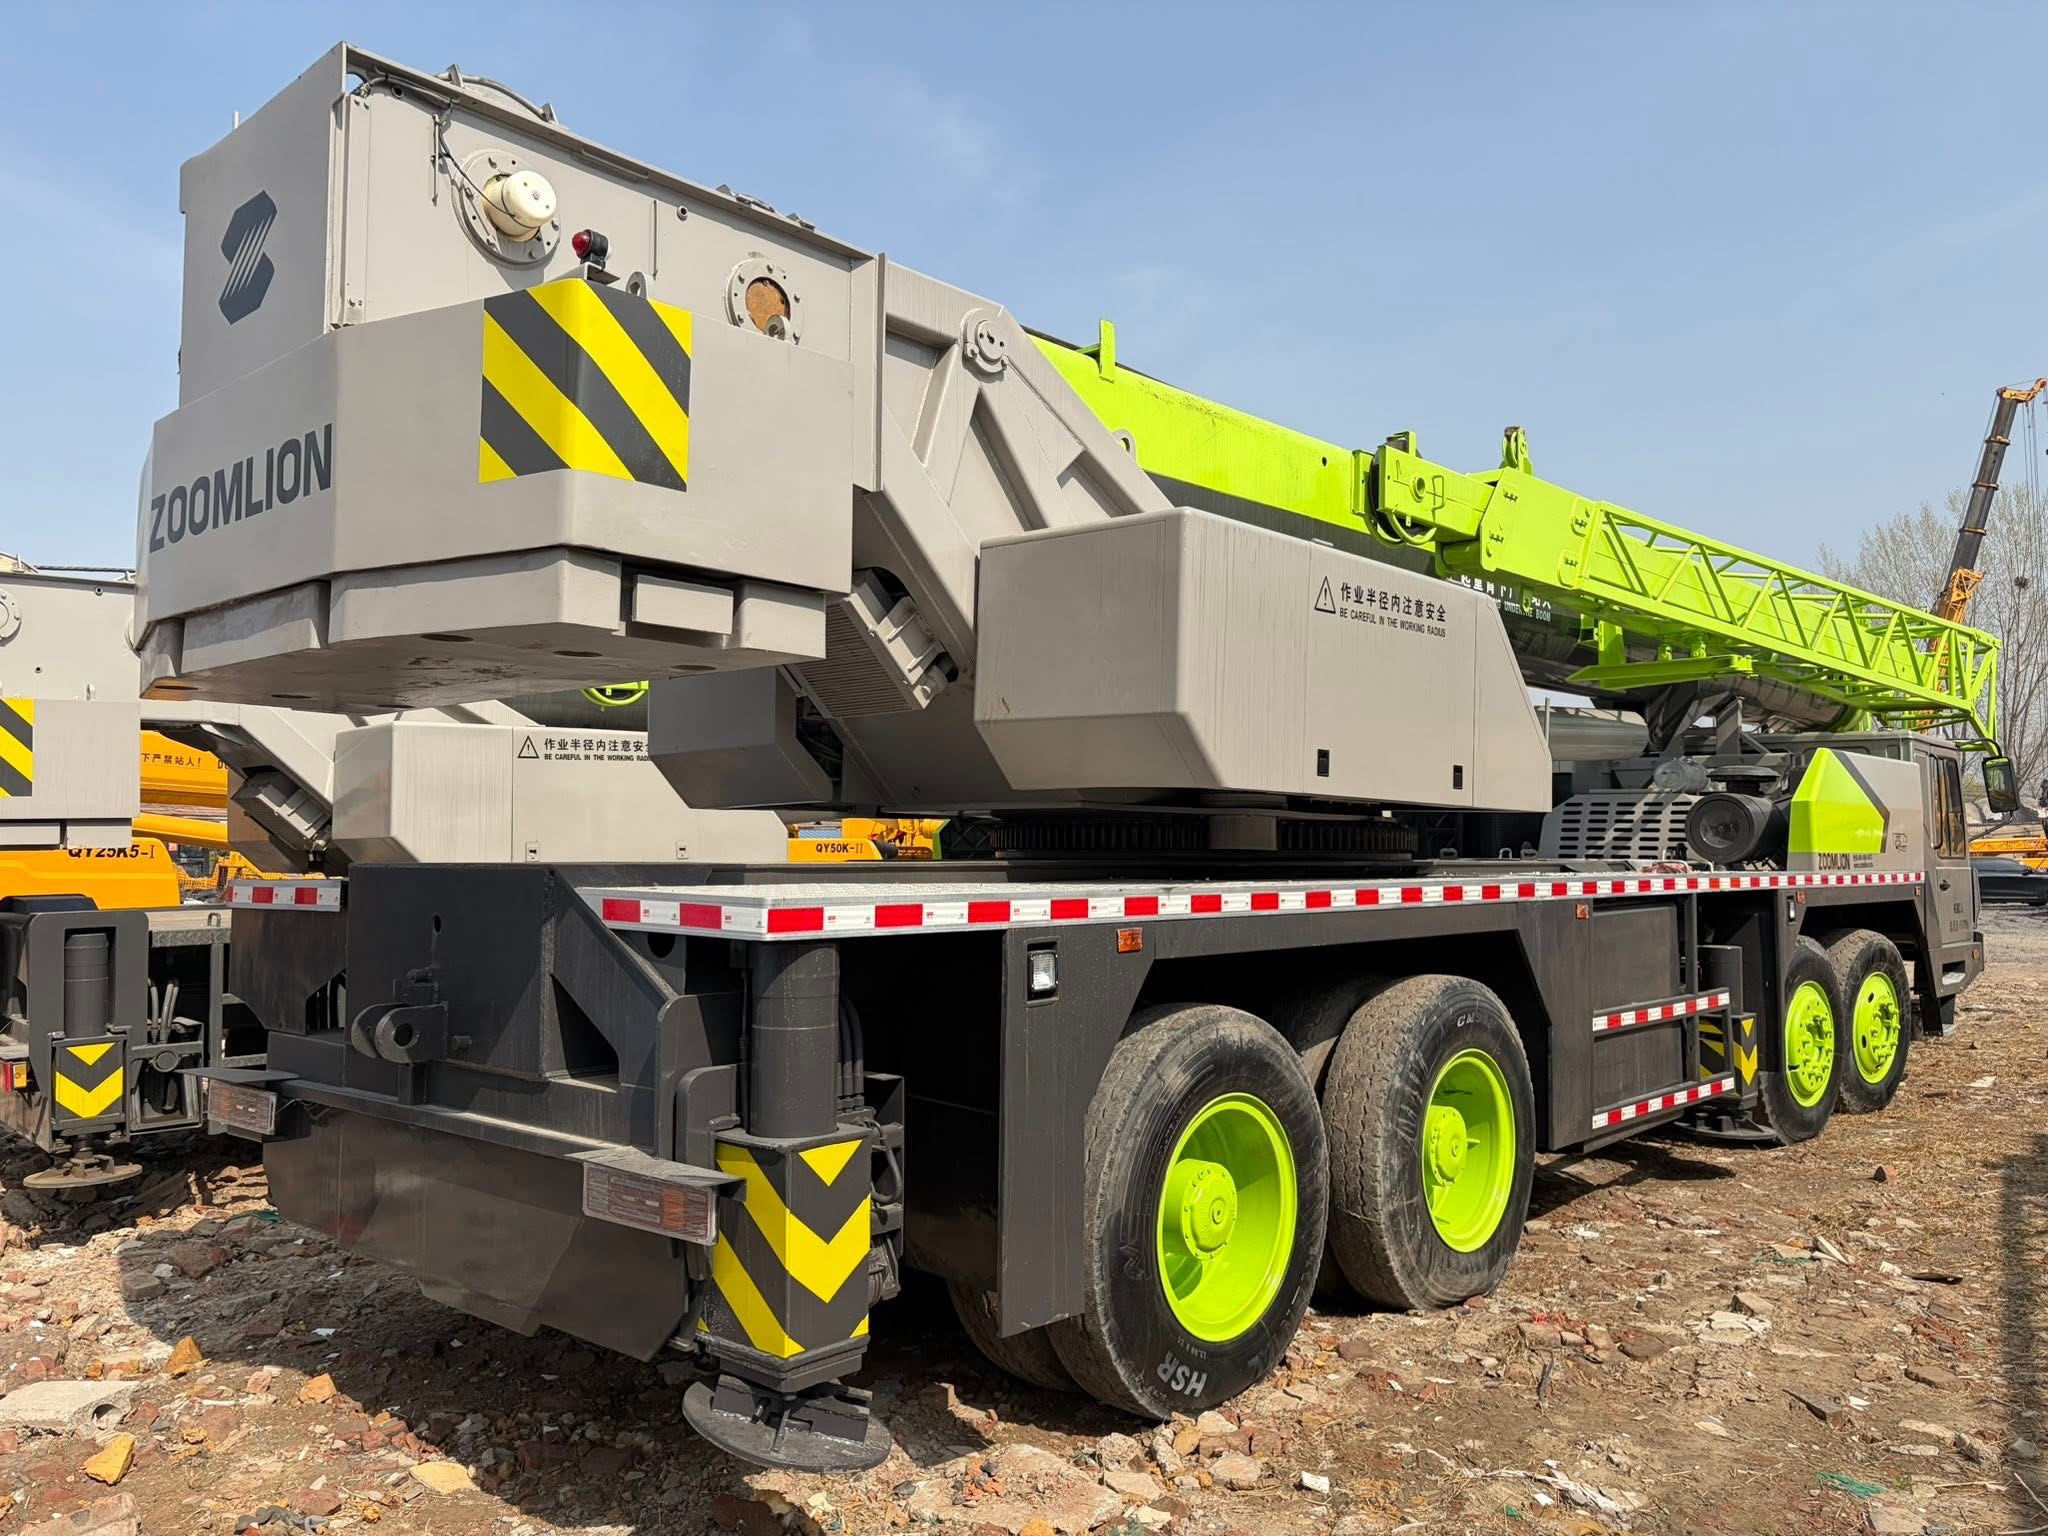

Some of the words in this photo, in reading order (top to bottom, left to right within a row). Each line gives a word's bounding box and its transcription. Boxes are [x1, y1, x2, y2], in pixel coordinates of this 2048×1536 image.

[149, 423, 333, 554] ZOOMLION
[1341, 582, 1446, 622] 作业半径内注意安全
[1340, 607, 1348, 618] BE
[1351, 610, 1376, 624] CAREFUL
[1379, 615, 1385, 625] IN
[1387, 617, 1398, 628] THE
[1400, 620, 1424, 633] WORKING
[1427, 626, 1446, 638] RADIUS
[1535, 609, 1551, 622] BOOM
[544, 738, 649, 752] 作业半径内注意安
[607, 754, 634, 762] WORKING
[1817, 853, 1851, 871] ZOOMLION
[1157, 1349, 1208, 1398] HSR
